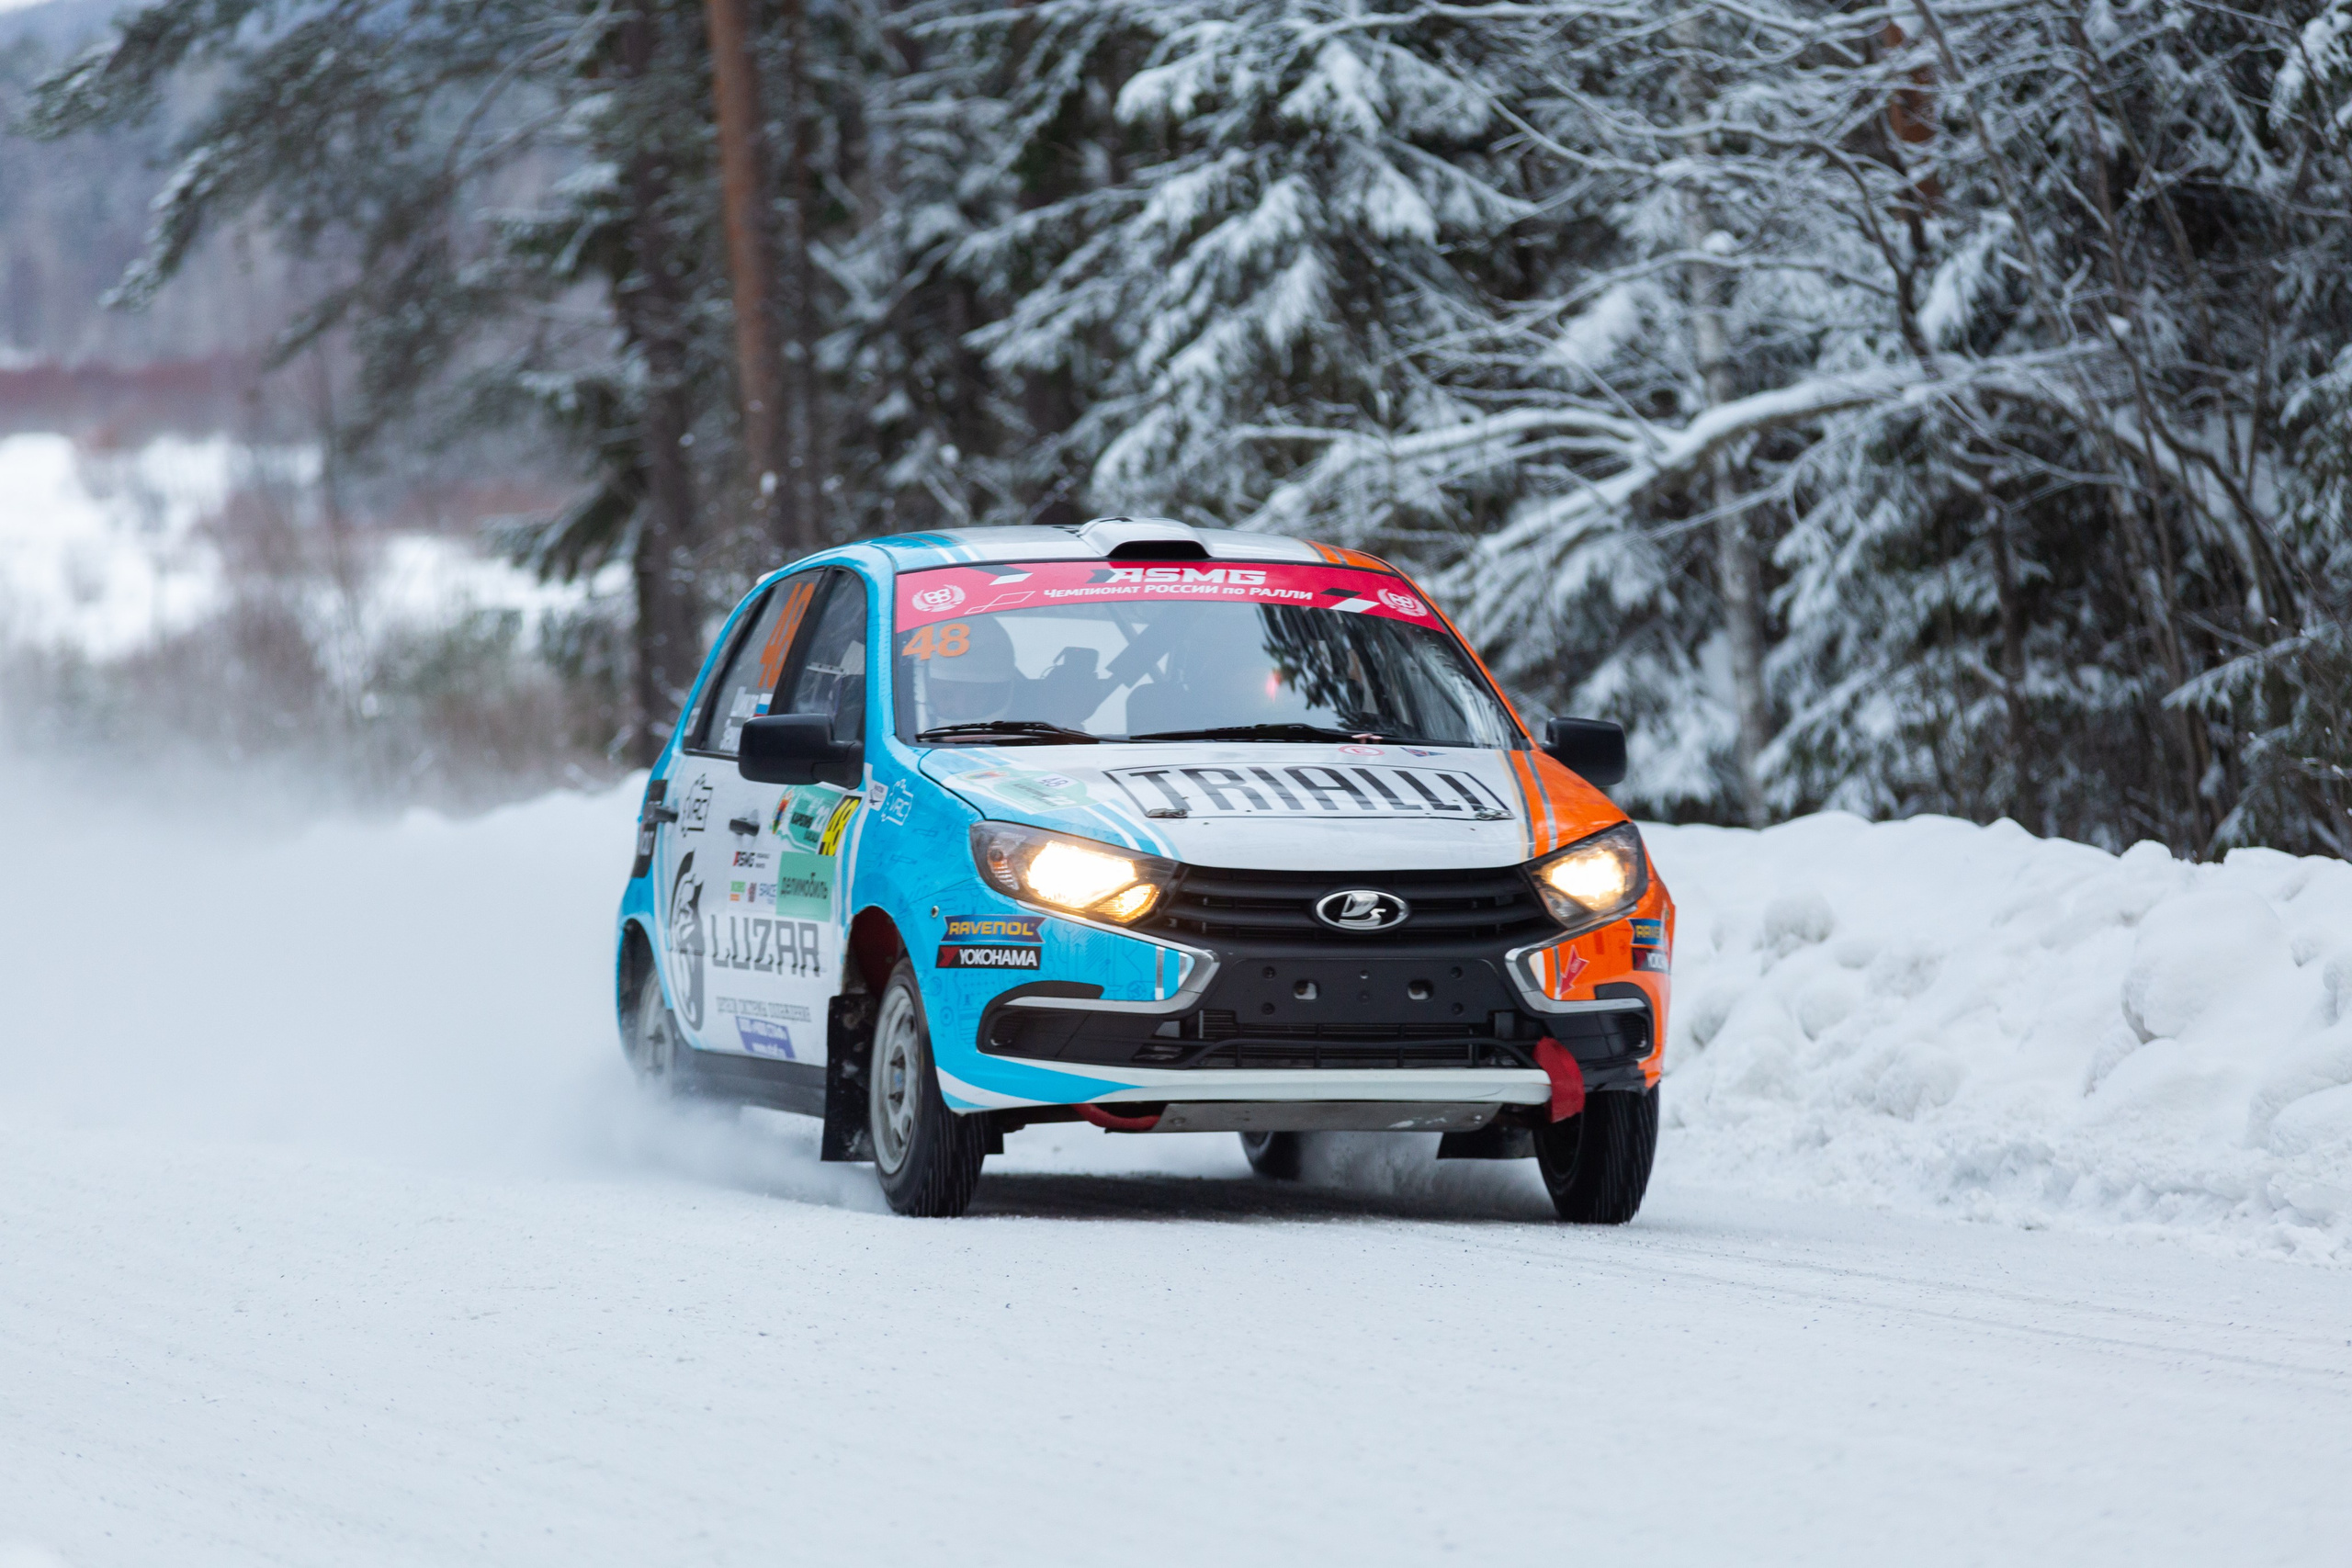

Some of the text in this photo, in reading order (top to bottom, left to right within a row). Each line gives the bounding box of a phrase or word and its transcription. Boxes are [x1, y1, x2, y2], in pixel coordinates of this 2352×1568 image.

[1144, 584, 1219, 595] РОССИИ
[1250, 588, 1313, 600] РАЛЛИ
[901, 623, 971, 661] 48
[1039, 777, 1069, 787] 48
[1129, 765, 1490, 812] TRIALLI
[822, 797, 860, 857] 48
[948, 921, 1034, 936] RAVENOL
[710, 914, 820, 976] LUZAR
[959, 949, 1038, 966] YOKOHAMA
